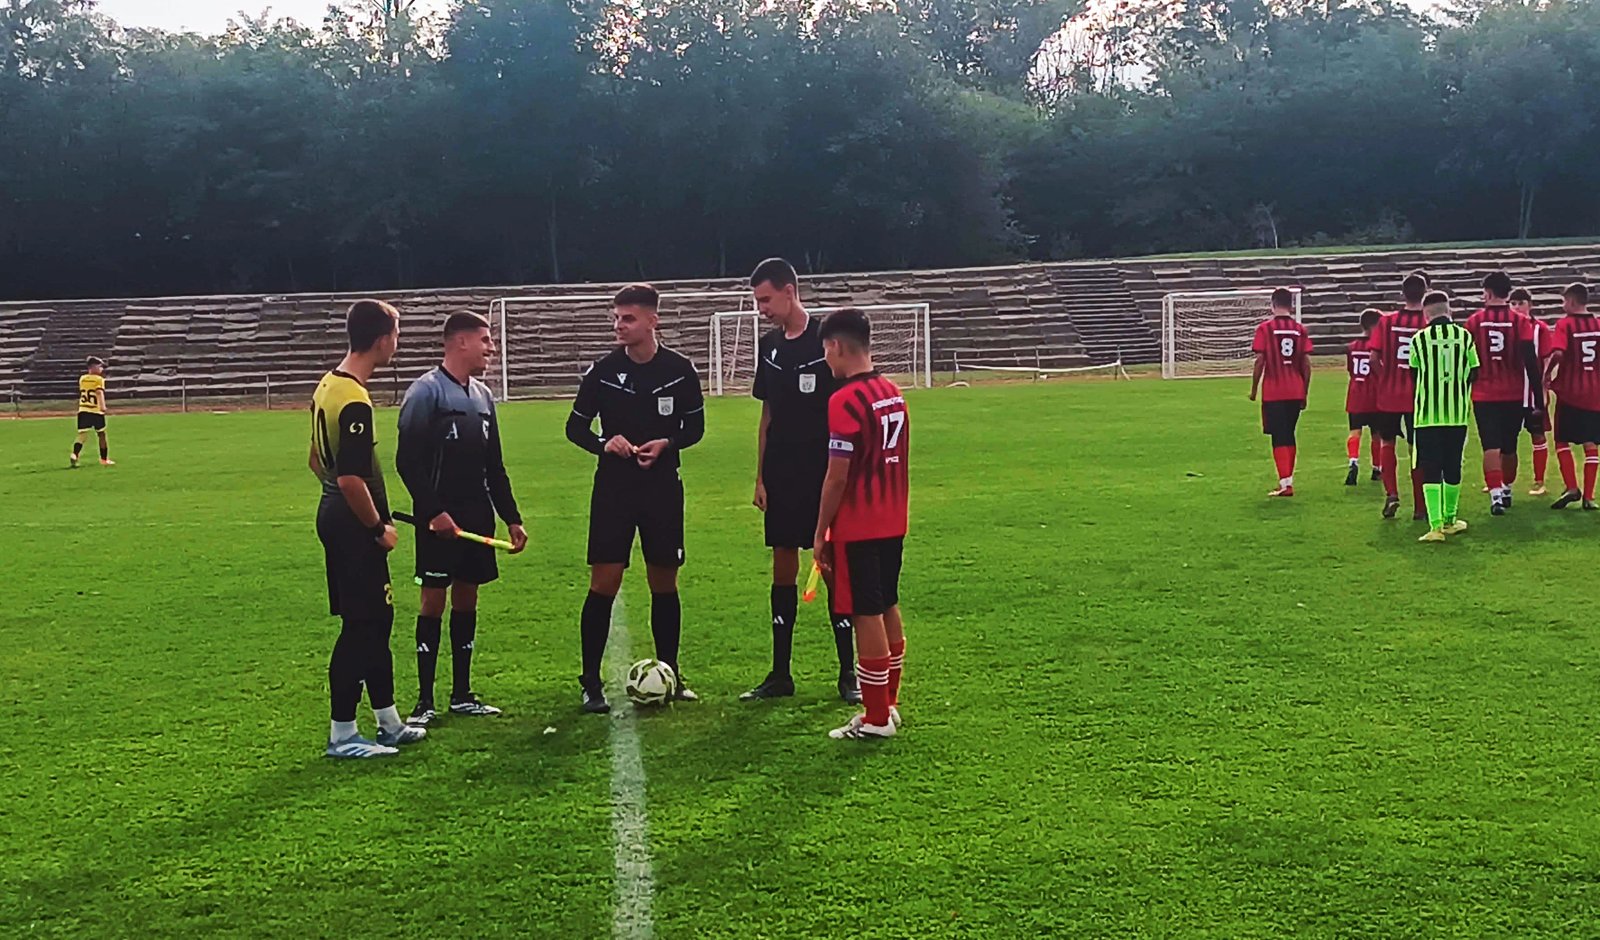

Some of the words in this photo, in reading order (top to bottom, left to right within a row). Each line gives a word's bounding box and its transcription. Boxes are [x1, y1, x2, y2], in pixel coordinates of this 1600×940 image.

[1281, 337, 1294, 357] 8
[1489, 330, 1504, 352] 3
[1582, 341, 1597, 363] 5
[1353, 357, 1370, 376] 16
[881, 411, 905, 450] 17
